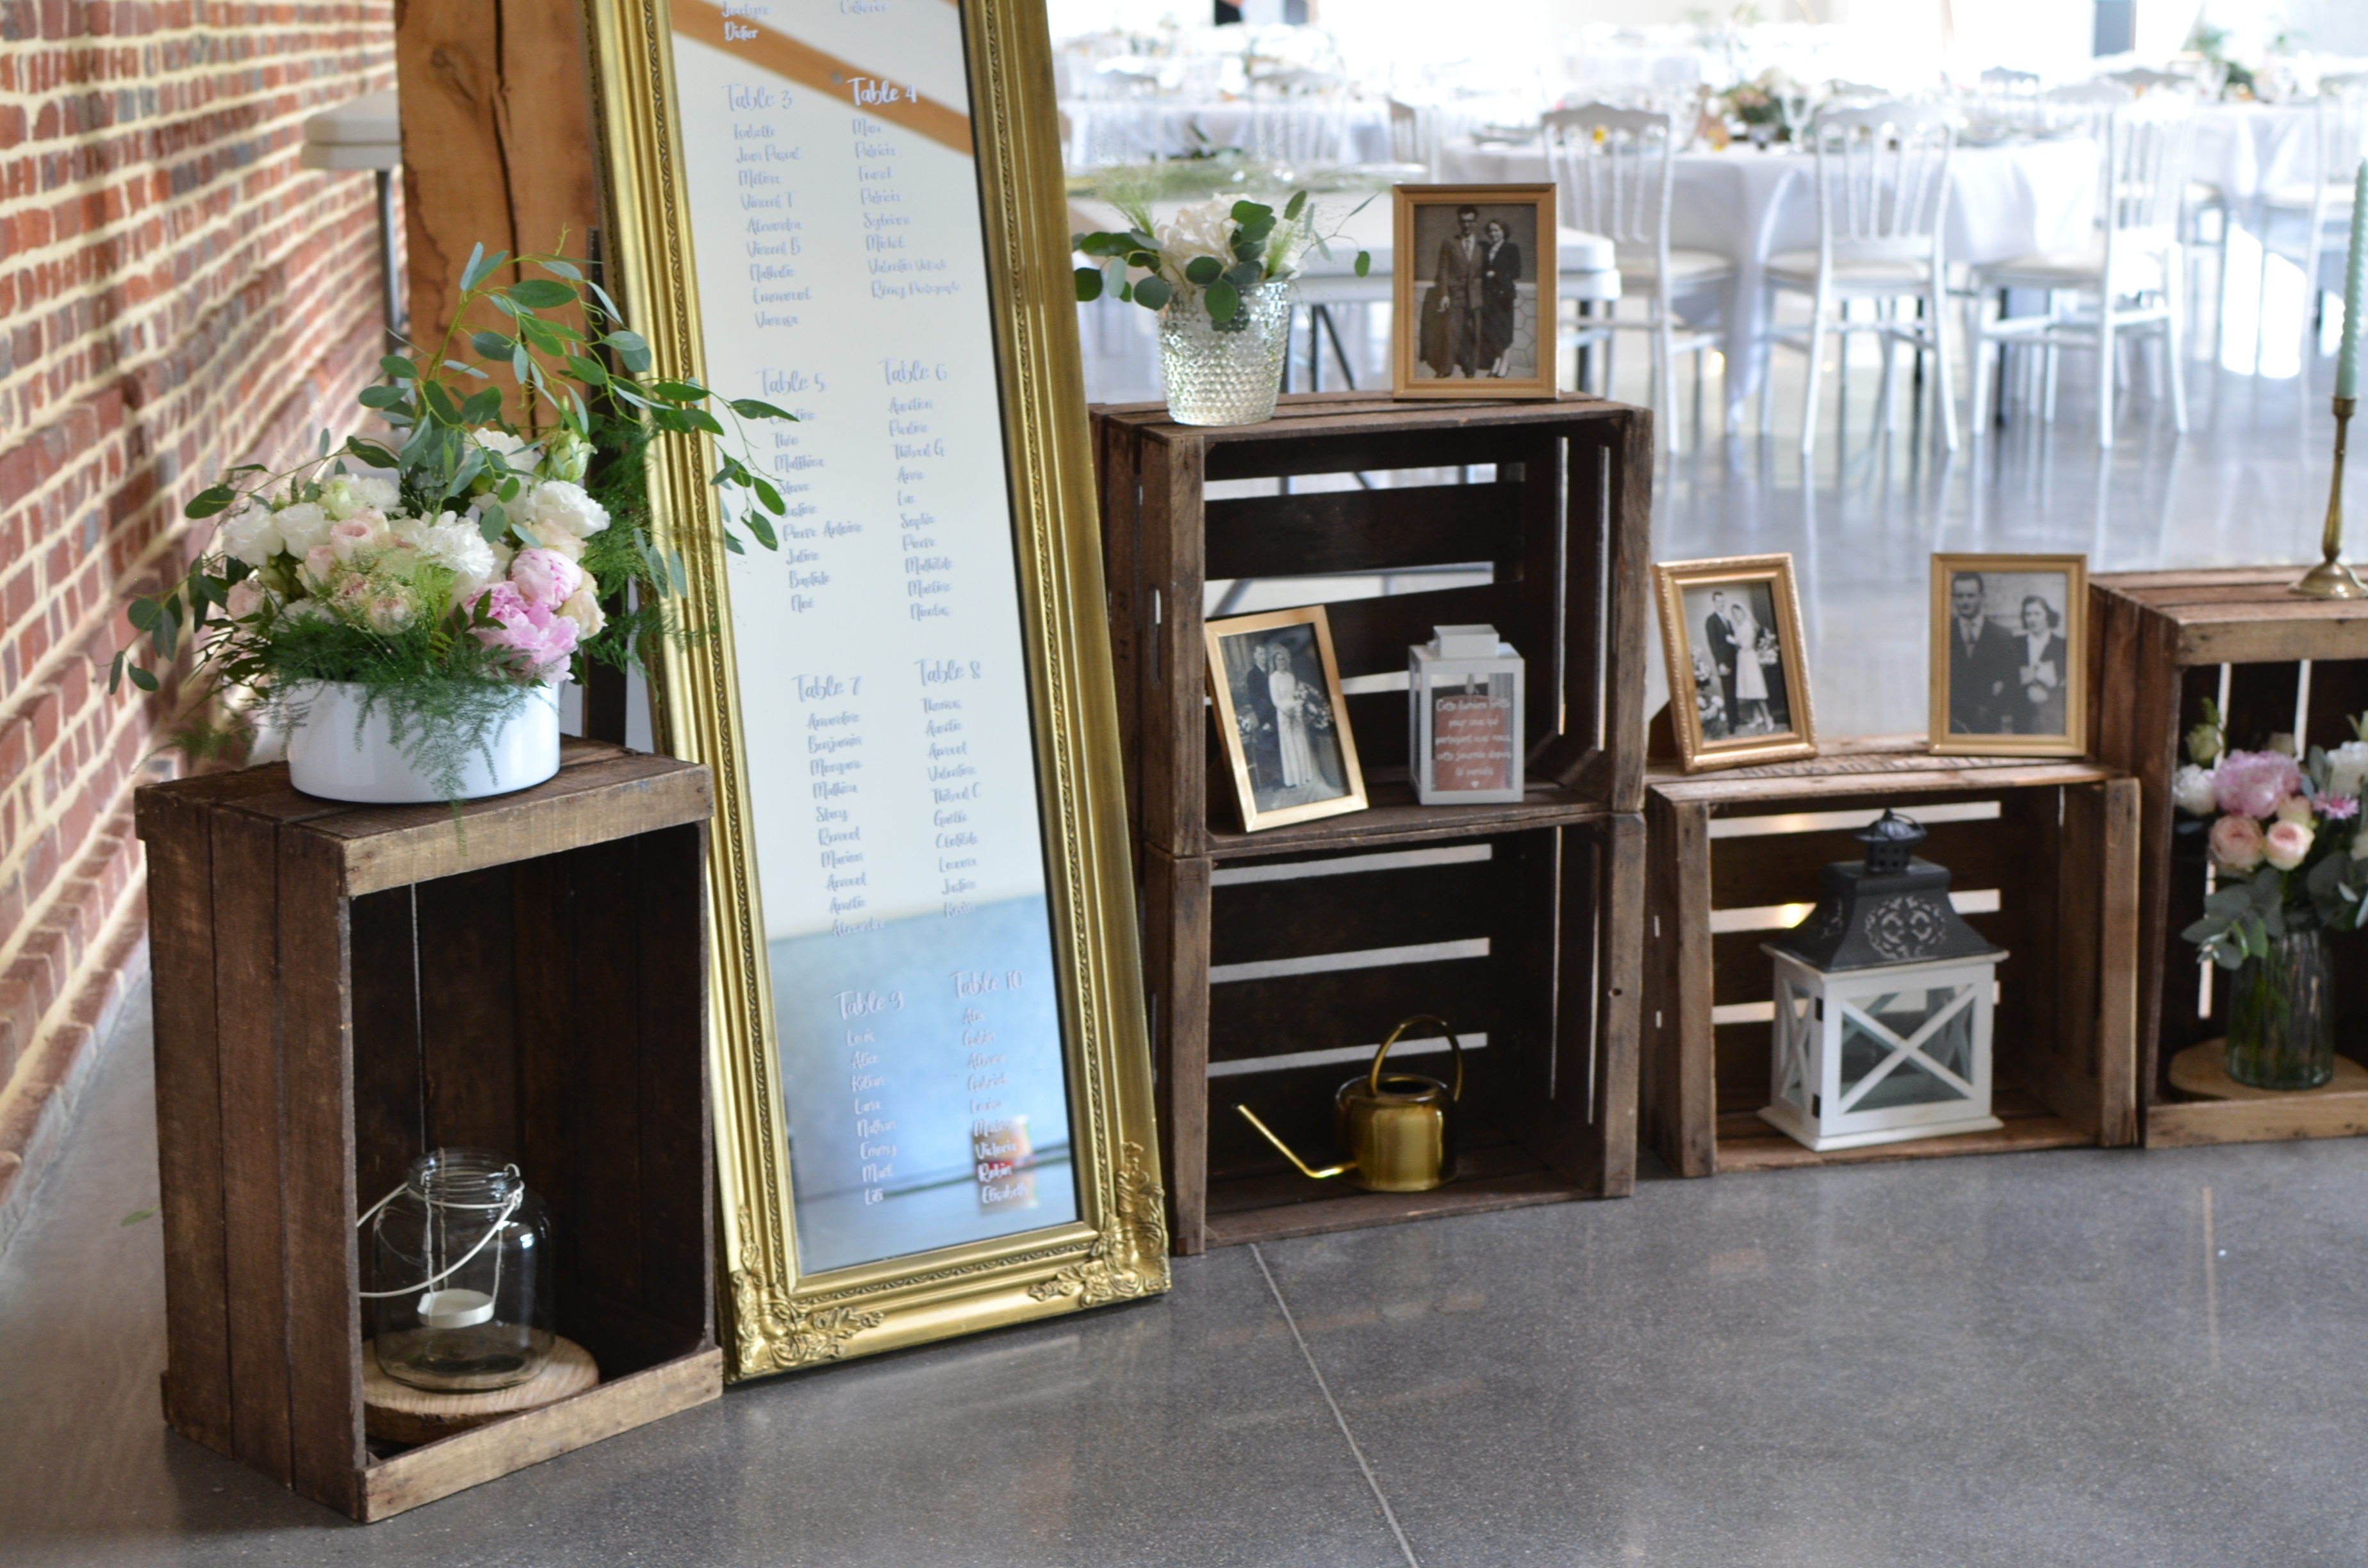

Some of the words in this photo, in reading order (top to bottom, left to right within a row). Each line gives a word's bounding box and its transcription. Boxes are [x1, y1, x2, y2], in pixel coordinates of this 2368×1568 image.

[724, 21, 759, 41] Didier
[721, 83, 775, 111] Table
[781, 90, 793, 109] 3
[846, 77, 900, 106] Table
[905, 85, 917, 104] 4
[734, 123, 776, 140] Isabelle
[736, 145, 762, 164] Jean
[765, 143, 802, 162] Pascal
[741, 193, 782, 211] Vincent
[784, 190, 795, 208] T
[746, 240, 787, 257] Vincent
[790, 236, 802, 256] B
[866, 234, 905, 253] Michel
[750, 263, 794, 282] Nathalie
[753, 286, 812, 304] Emmanuel
[755, 311, 800, 328] Vanessa
[755, 368, 810, 396] Table
[814, 372, 828, 393] 5
[878, 358, 930, 386] Table
[935, 363, 949, 382] 6
[783, 523, 818, 542] Pierre
[823, 520, 864, 539] Antoine
[900, 512, 936, 530] Sophie
[902, 534, 936, 551] Pierre
[905, 556, 953, 575] Mathilde
[914, 658, 965, 686] Table
[969, 660, 982, 679] 8
[791, 673, 844, 702] Table
[849, 676, 863, 696] 7
[807, 733, 862, 754] Benjamin
[810, 758, 863, 778] Morgane
[972, 781, 983, 799] C
[935, 831, 979, 849] Clotilde
[949, 970, 1000, 999] Table
[1005, 970, 1025, 991] 10
[834, 990, 885, 1020] Table
[889, 990, 904, 1011] 9
[846, 1029, 875, 1047] Louis
[967, 1072, 1009, 1093] Gabriel
[857, 1118, 896, 1138] Nathan
[975, 1140, 1017, 1159] Victoria
[978, 1163, 1012, 1183] Robin
